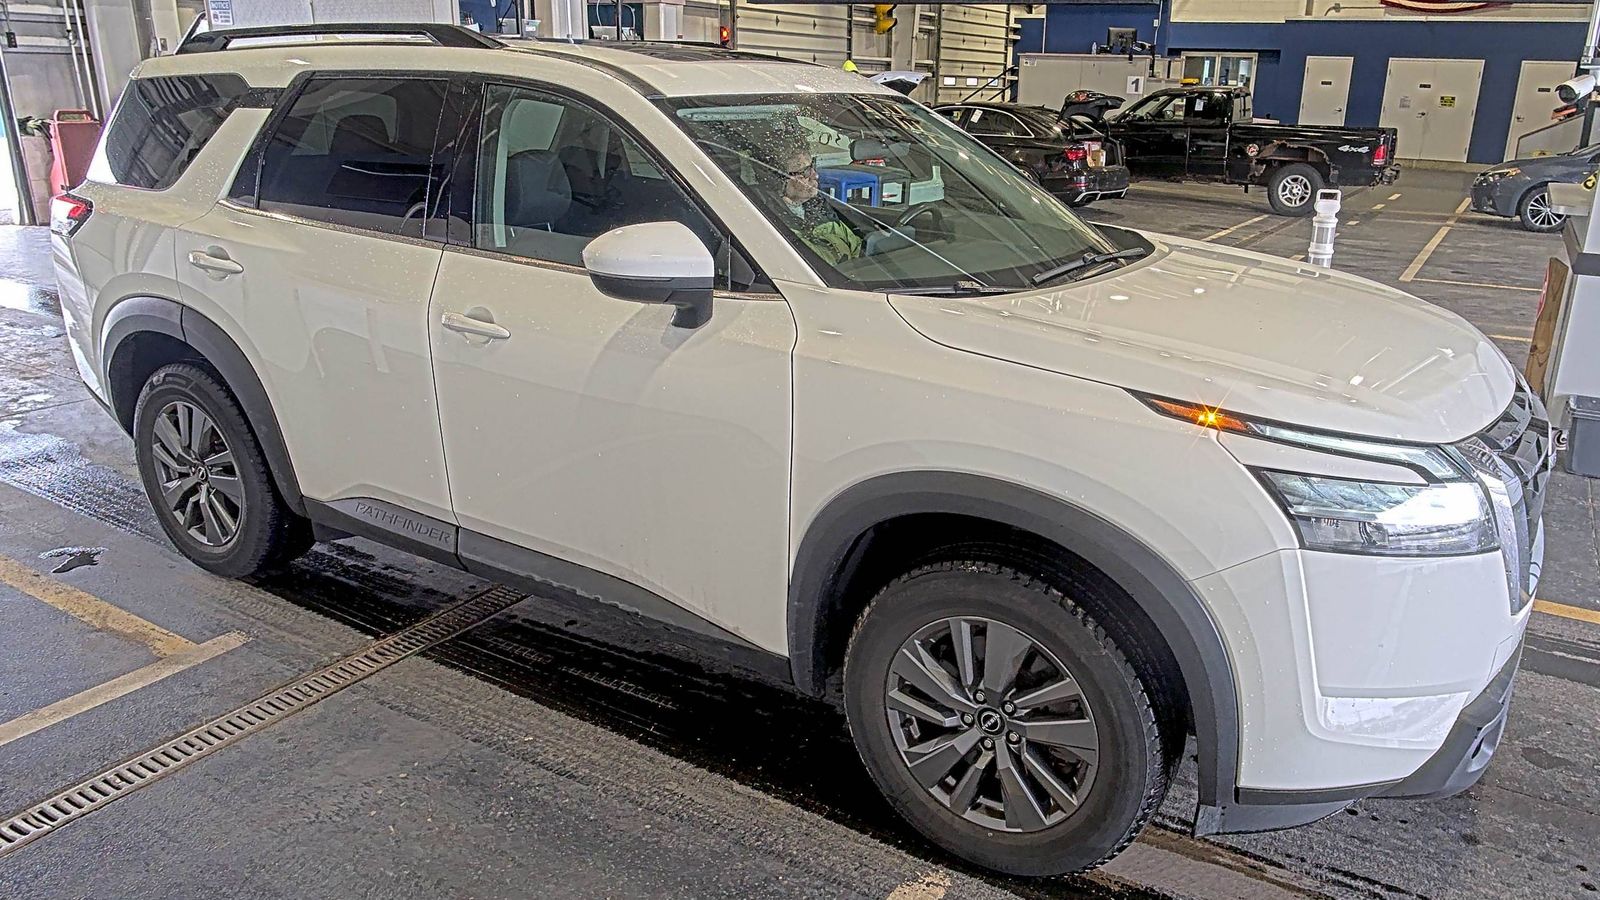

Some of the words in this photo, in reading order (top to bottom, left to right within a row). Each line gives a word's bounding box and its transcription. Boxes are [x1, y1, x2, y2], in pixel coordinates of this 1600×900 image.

[1131, 77, 1140, 92] 1
[1337, 145, 1370, 154] 4x4
[355, 502, 452, 543] PATHFINDER
